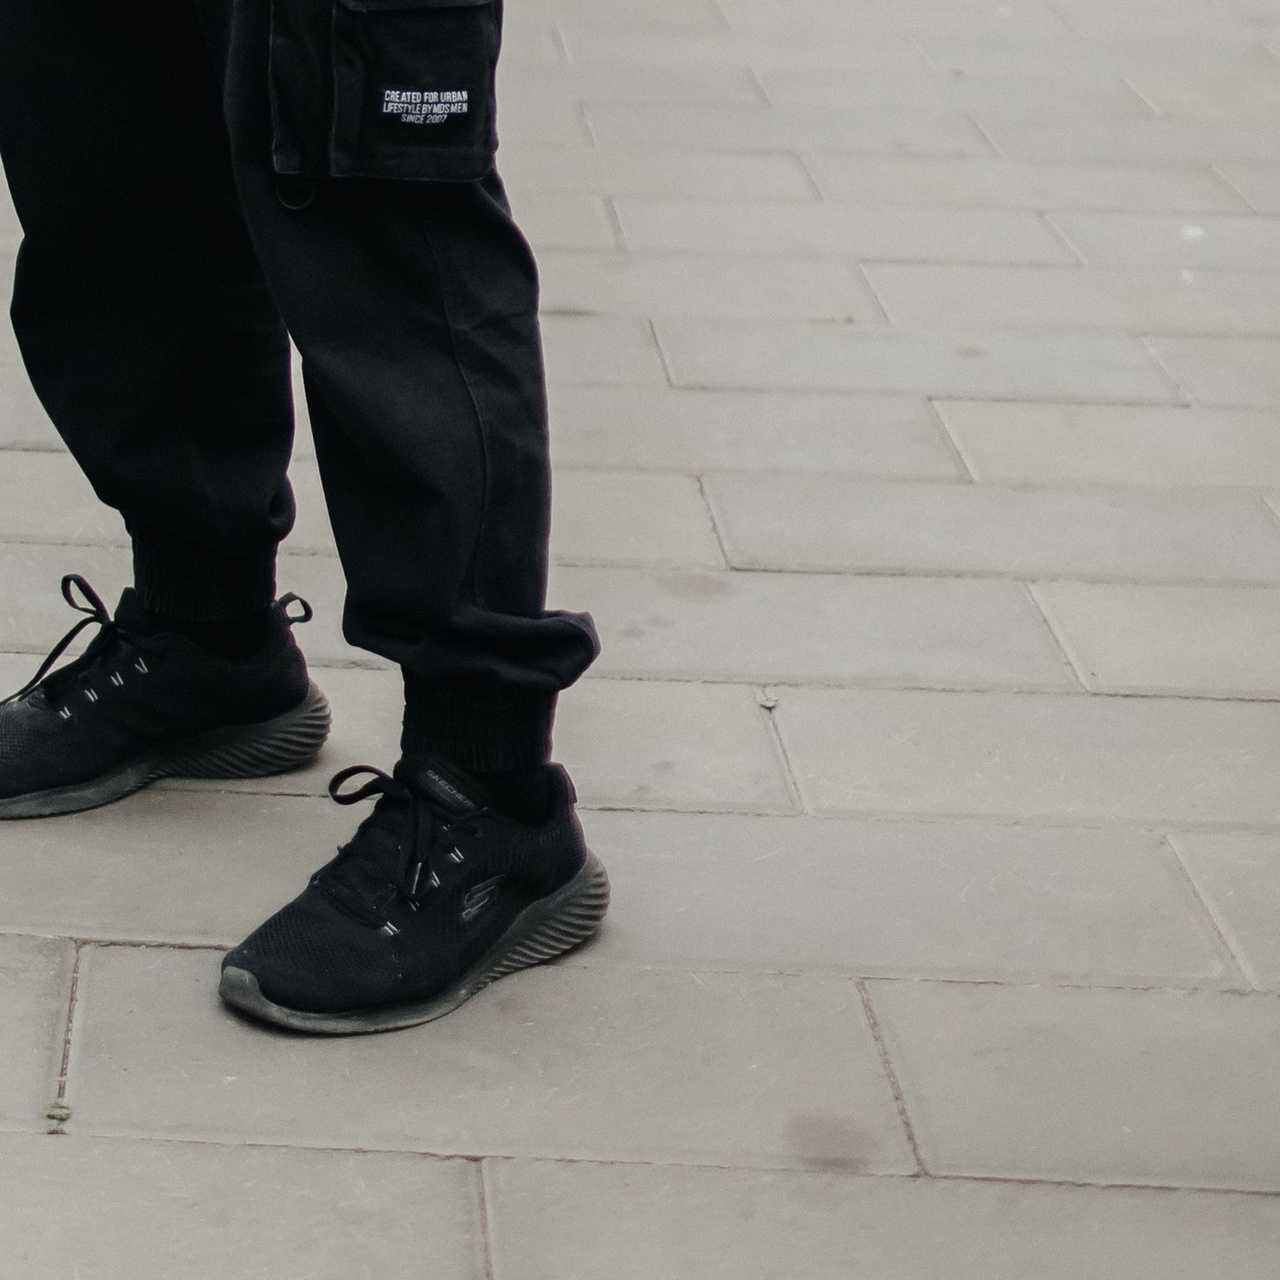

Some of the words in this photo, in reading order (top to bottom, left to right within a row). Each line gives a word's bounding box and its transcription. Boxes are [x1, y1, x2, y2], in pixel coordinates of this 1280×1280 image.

[384, 90, 422, 103] CREATED
[424, 91, 439, 103] FOR
[440, 90, 468, 102] URBAN
[383, 102, 421, 114] LIFESTYLE
[401, 114, 426, 124] SINCE
[426, 114, 448, 124] 2007
